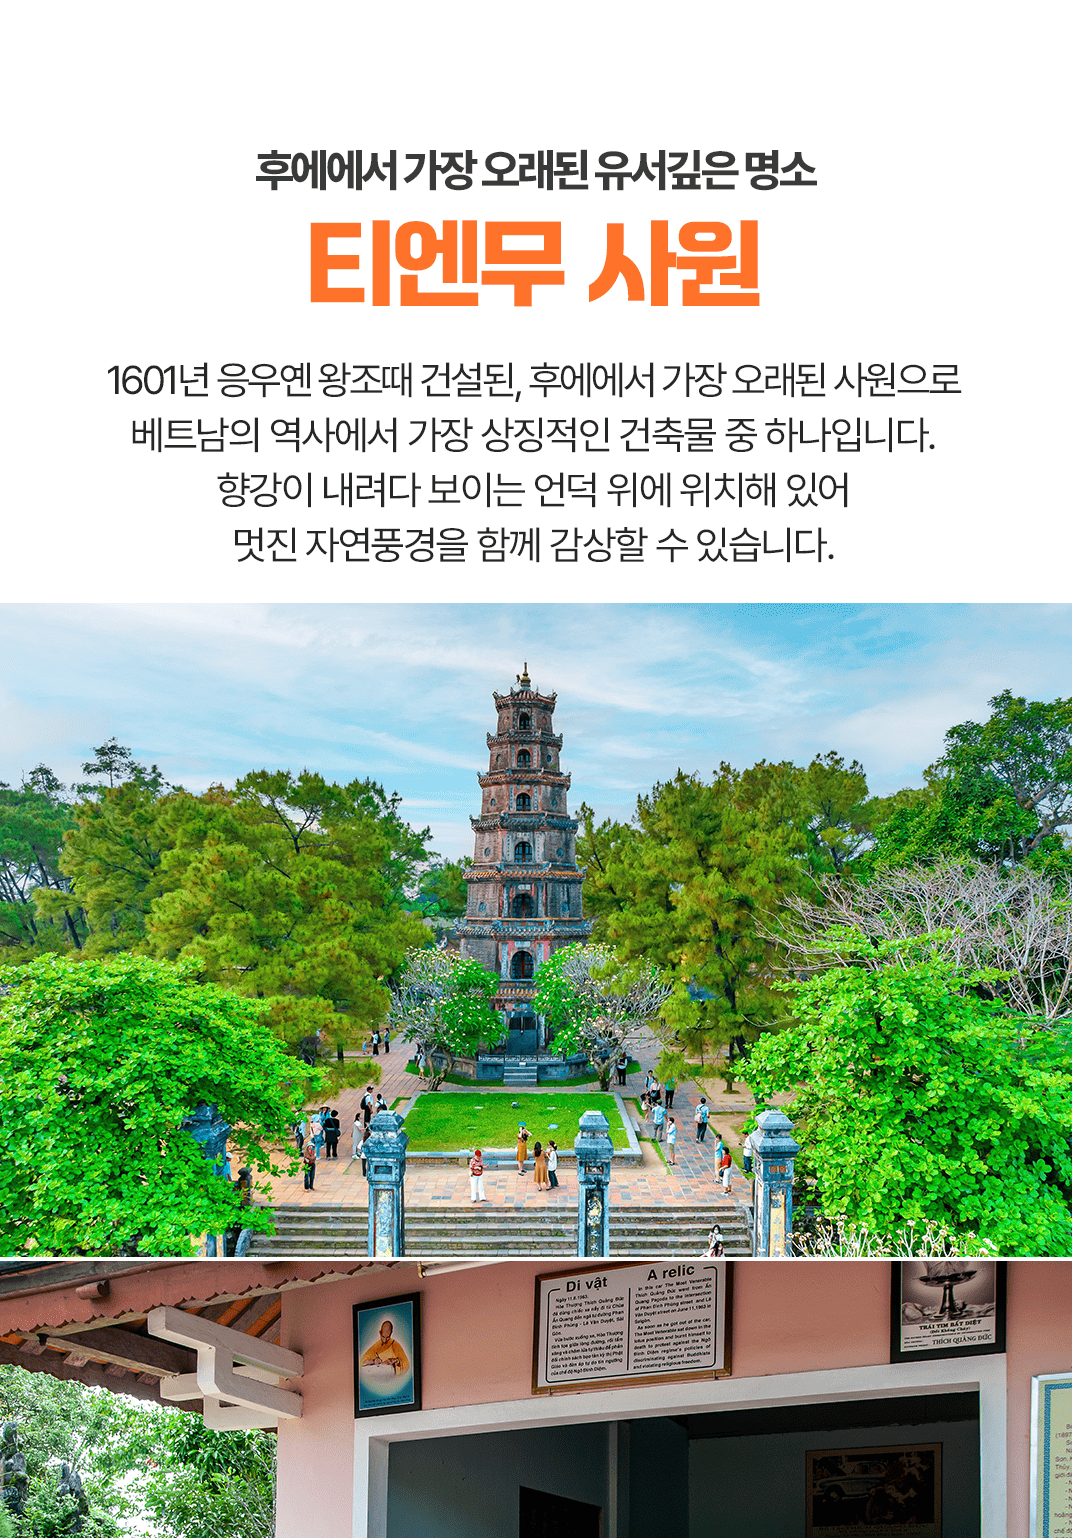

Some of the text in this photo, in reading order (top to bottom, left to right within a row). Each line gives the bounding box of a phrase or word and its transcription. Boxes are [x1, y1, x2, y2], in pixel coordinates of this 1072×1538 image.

[647, 1264, 694, 1281] A relic
[567, 1277, 607, 1292] Di vật
